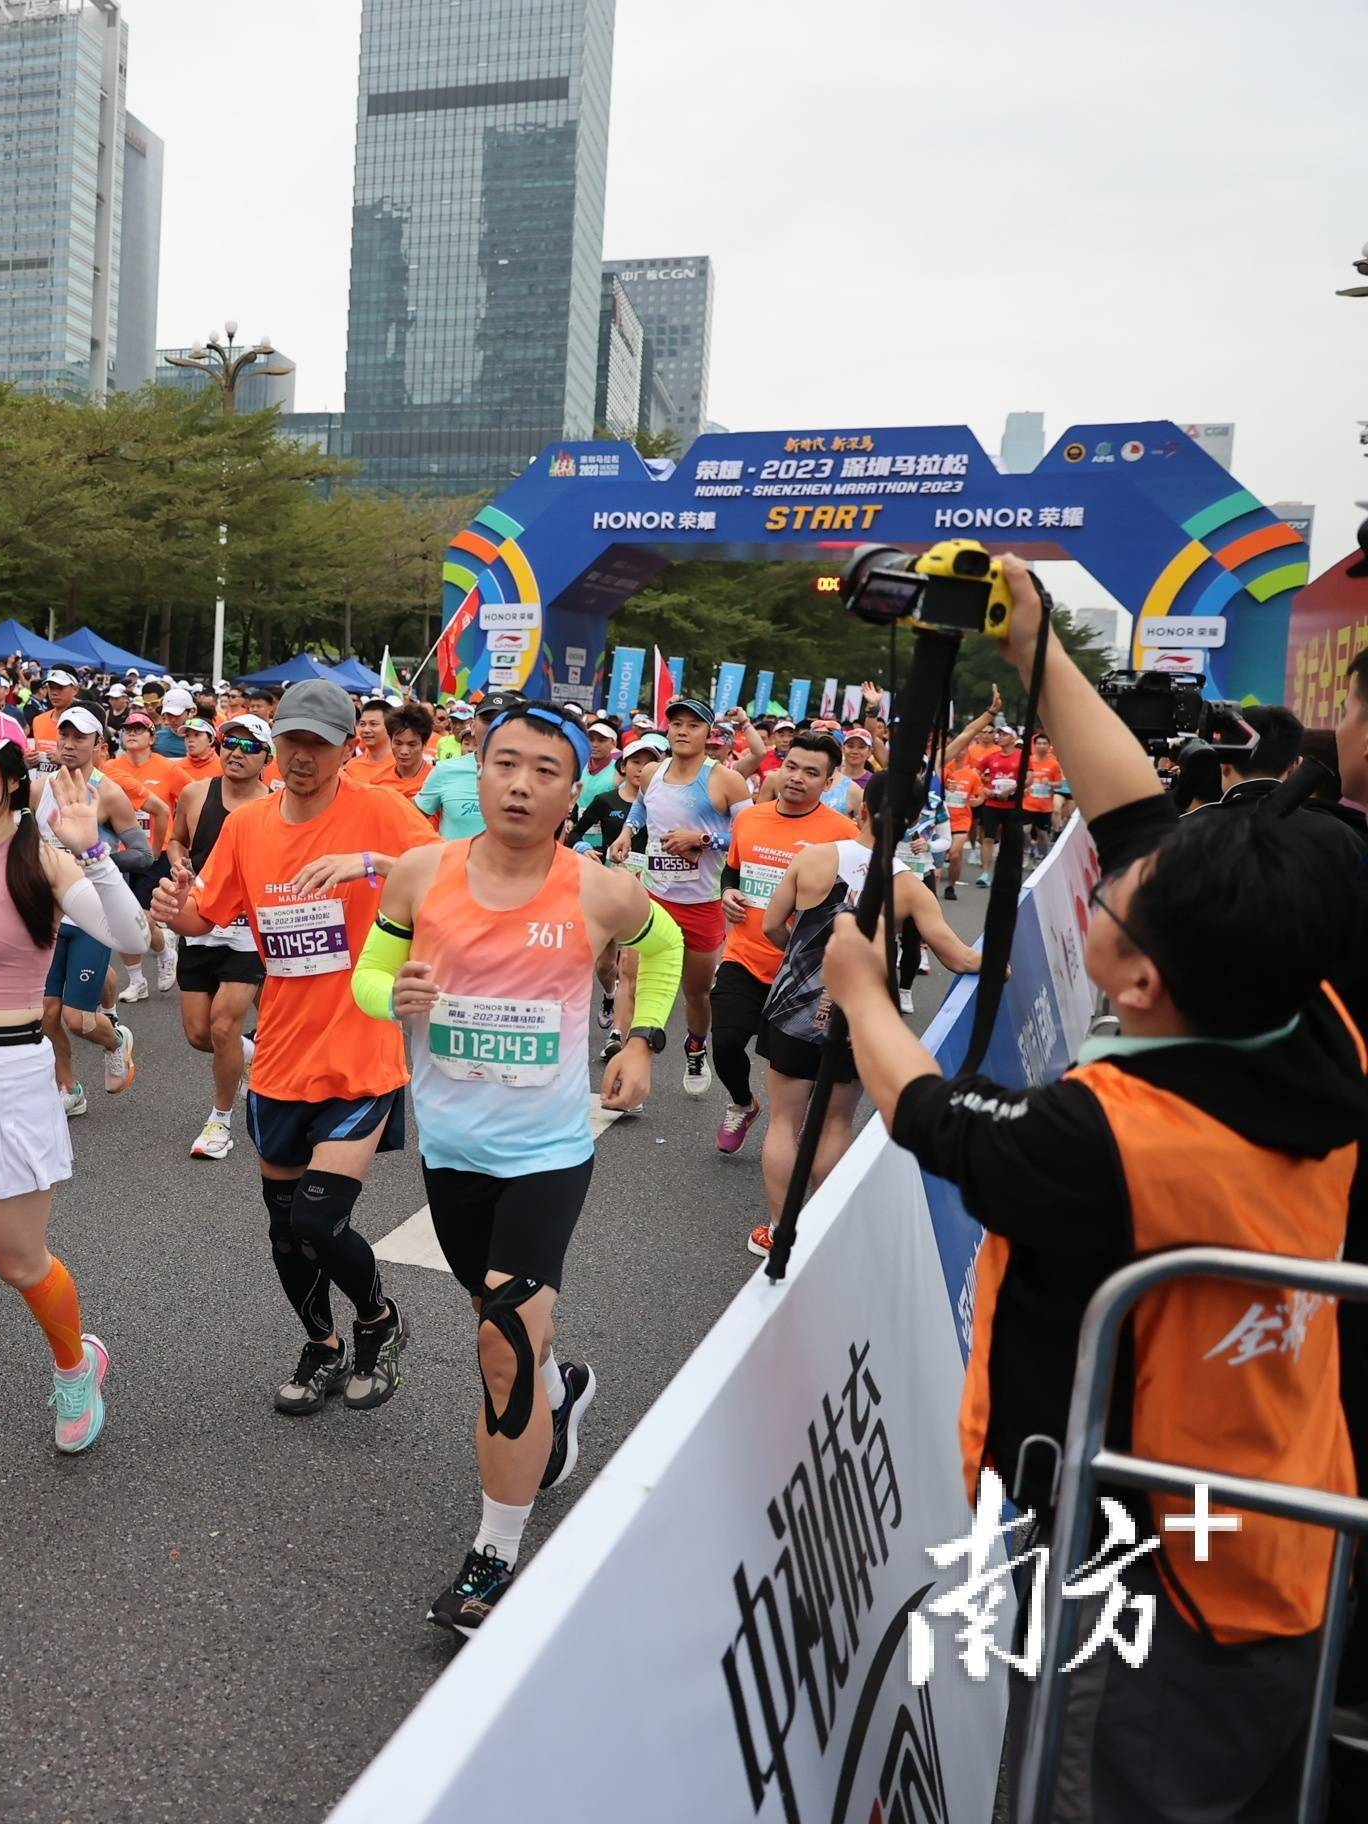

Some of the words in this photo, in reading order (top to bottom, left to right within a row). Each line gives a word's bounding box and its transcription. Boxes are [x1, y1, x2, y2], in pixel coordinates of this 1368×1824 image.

[579, 463, 599, 476] 2023
[695, 459, 744, 481] 荣耀
[760, 457, 834, 480] 2023
[840, 454, 969, 479] 深圳马拉松
[695, 485, 743, 498] HONOR
[752, 483, 833, 497] SHENZHEN
[833, 481, 919, 496] MARATHON
[920, 480, 964, 494] 2023
[592, 511, 674, 531] HONOR
[678, 510, 717, 531] 荣耀
[764, 504, 883, 531] START
[934, 507, 1034, 529] HONOR
[1037, 506, 1085, 528] 荣耀
[484, 612, 518, 621] HONOR
[520, 612, 534, 620] 荣耀
[1147, 627, 1194, 637] HONOR
[1197, 627, 1219, 637] 荣耀
[616, 661, 633, 710] HONOR
[653, 857, 660, 870] C
[744, 879, 752, 893] D
[266, 935, 277, 956] C
[277, 929, 330, 957] 11452
[525, 920, 574, 949] 361°
[473, 1003, 503, 1011] HONOR
[450, 1029, 465, 1055] D
[470, 1031, 538, 1062] 12143
